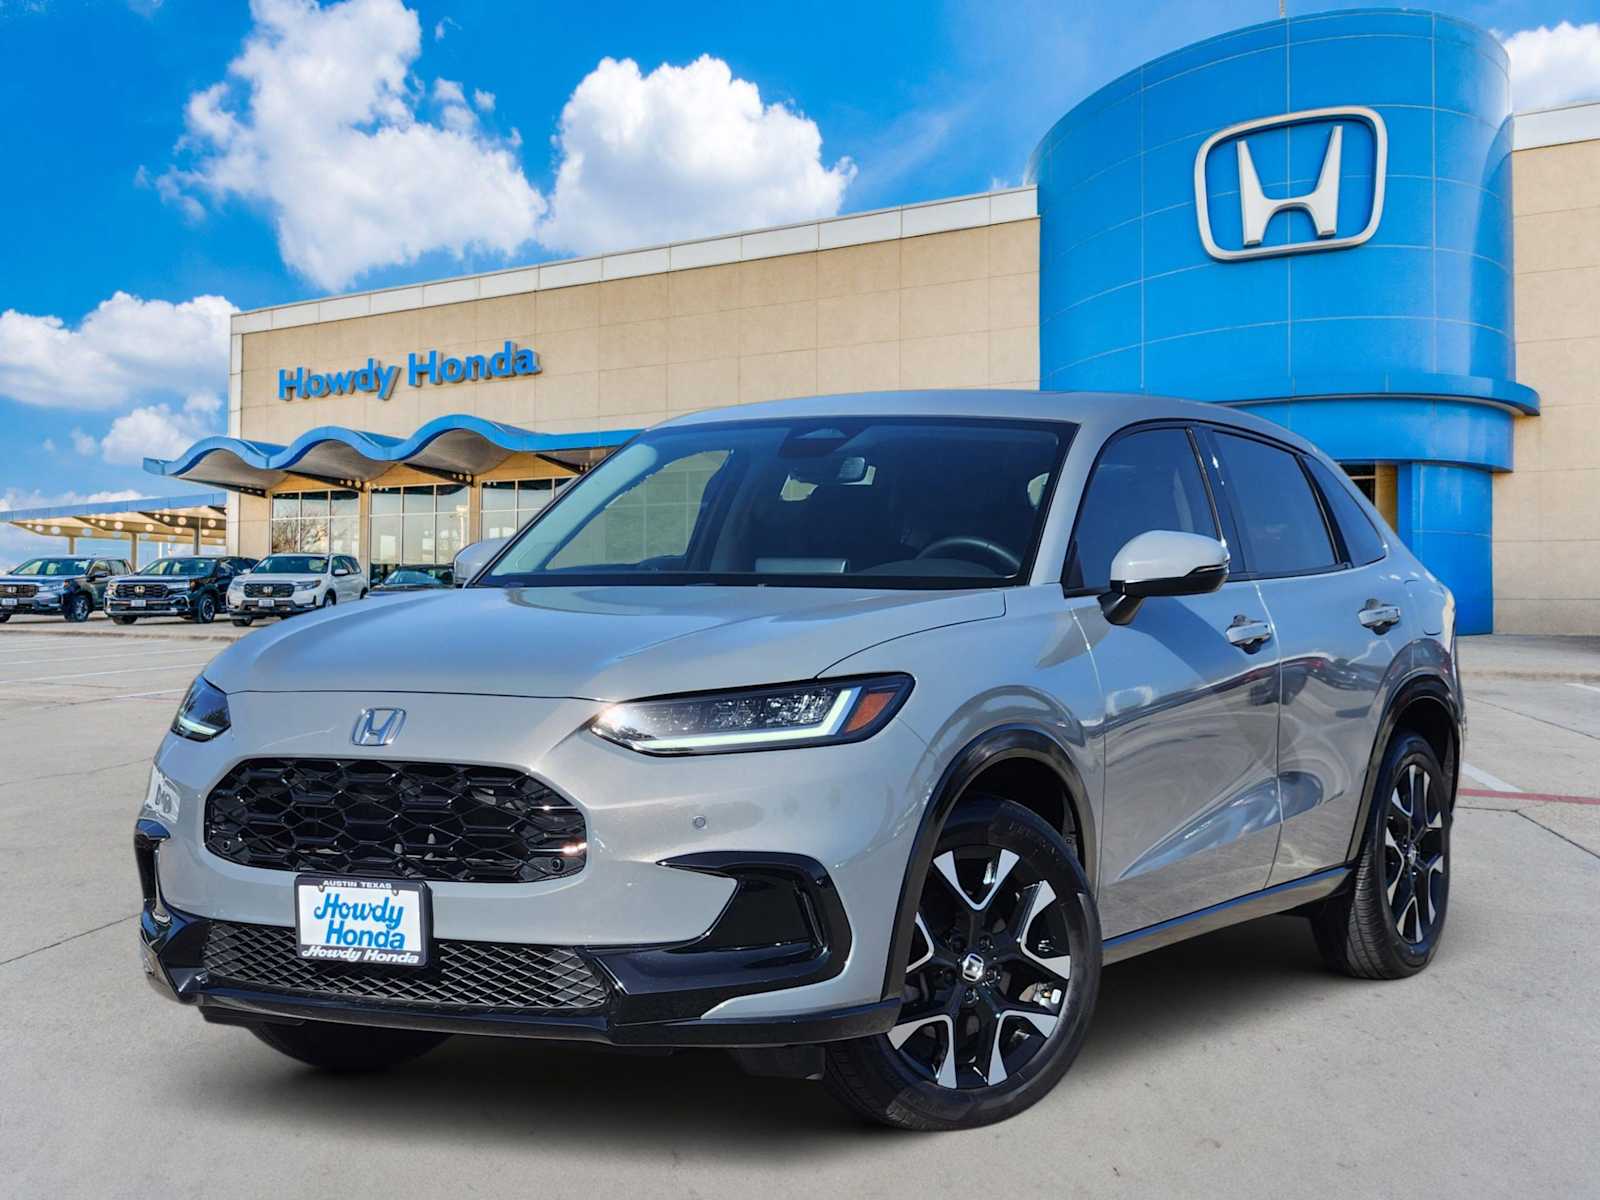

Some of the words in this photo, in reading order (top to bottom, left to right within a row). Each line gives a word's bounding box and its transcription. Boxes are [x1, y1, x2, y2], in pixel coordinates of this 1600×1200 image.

[278, 357, 399, 401] Howdy
[408, 340, 543, 387] Honda
[322, 880, 357, 888] AUSTIN
[360, 881, 392, 889] TEXAS
[313, 892, 404, 930] Howdy
[325, 920, 406, 949] Honda
[301, 945, 362, 962] Howdy
[363, 949, 420, 964] Honda
